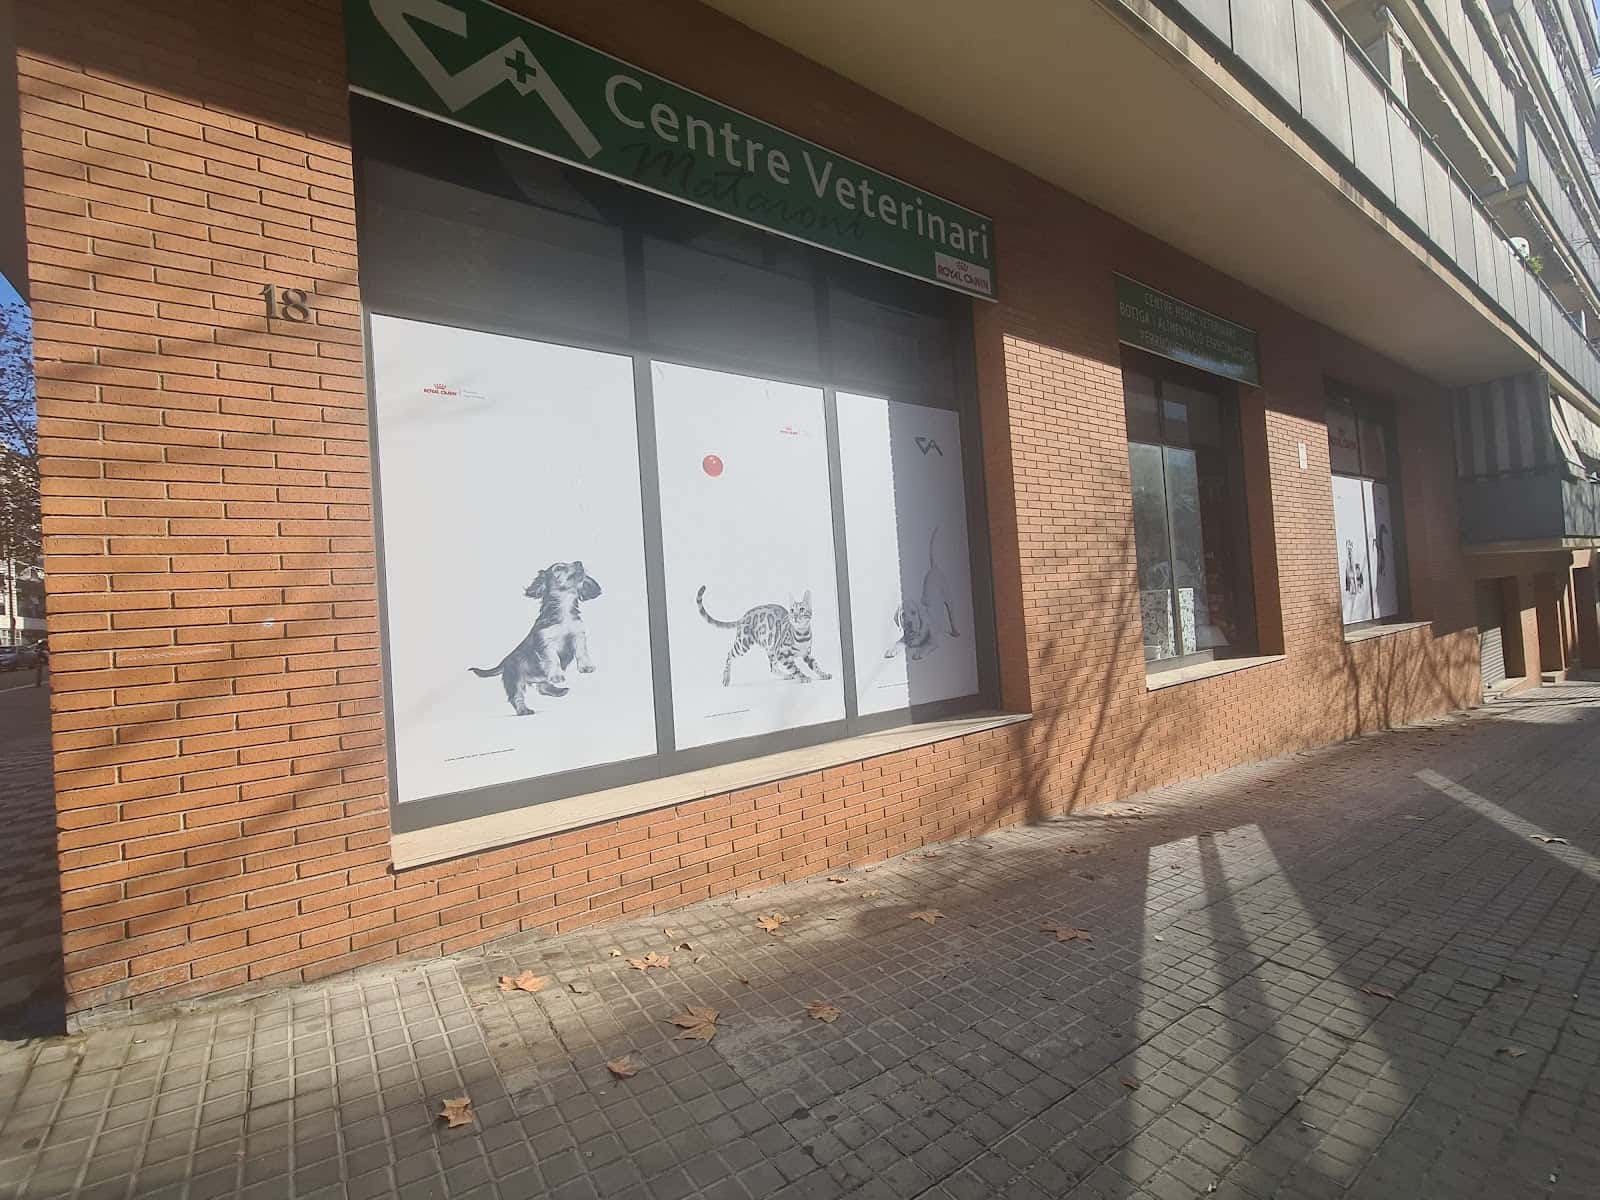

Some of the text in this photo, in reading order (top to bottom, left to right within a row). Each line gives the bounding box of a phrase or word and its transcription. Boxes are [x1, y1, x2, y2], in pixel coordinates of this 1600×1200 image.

[605, 75, 989, 259] Centre Veterinari
[937, 264, 963, 281] ROYAL
[258, 284, 309, 320] 18
[1119, 301, 1150, 322] BOTIGA
